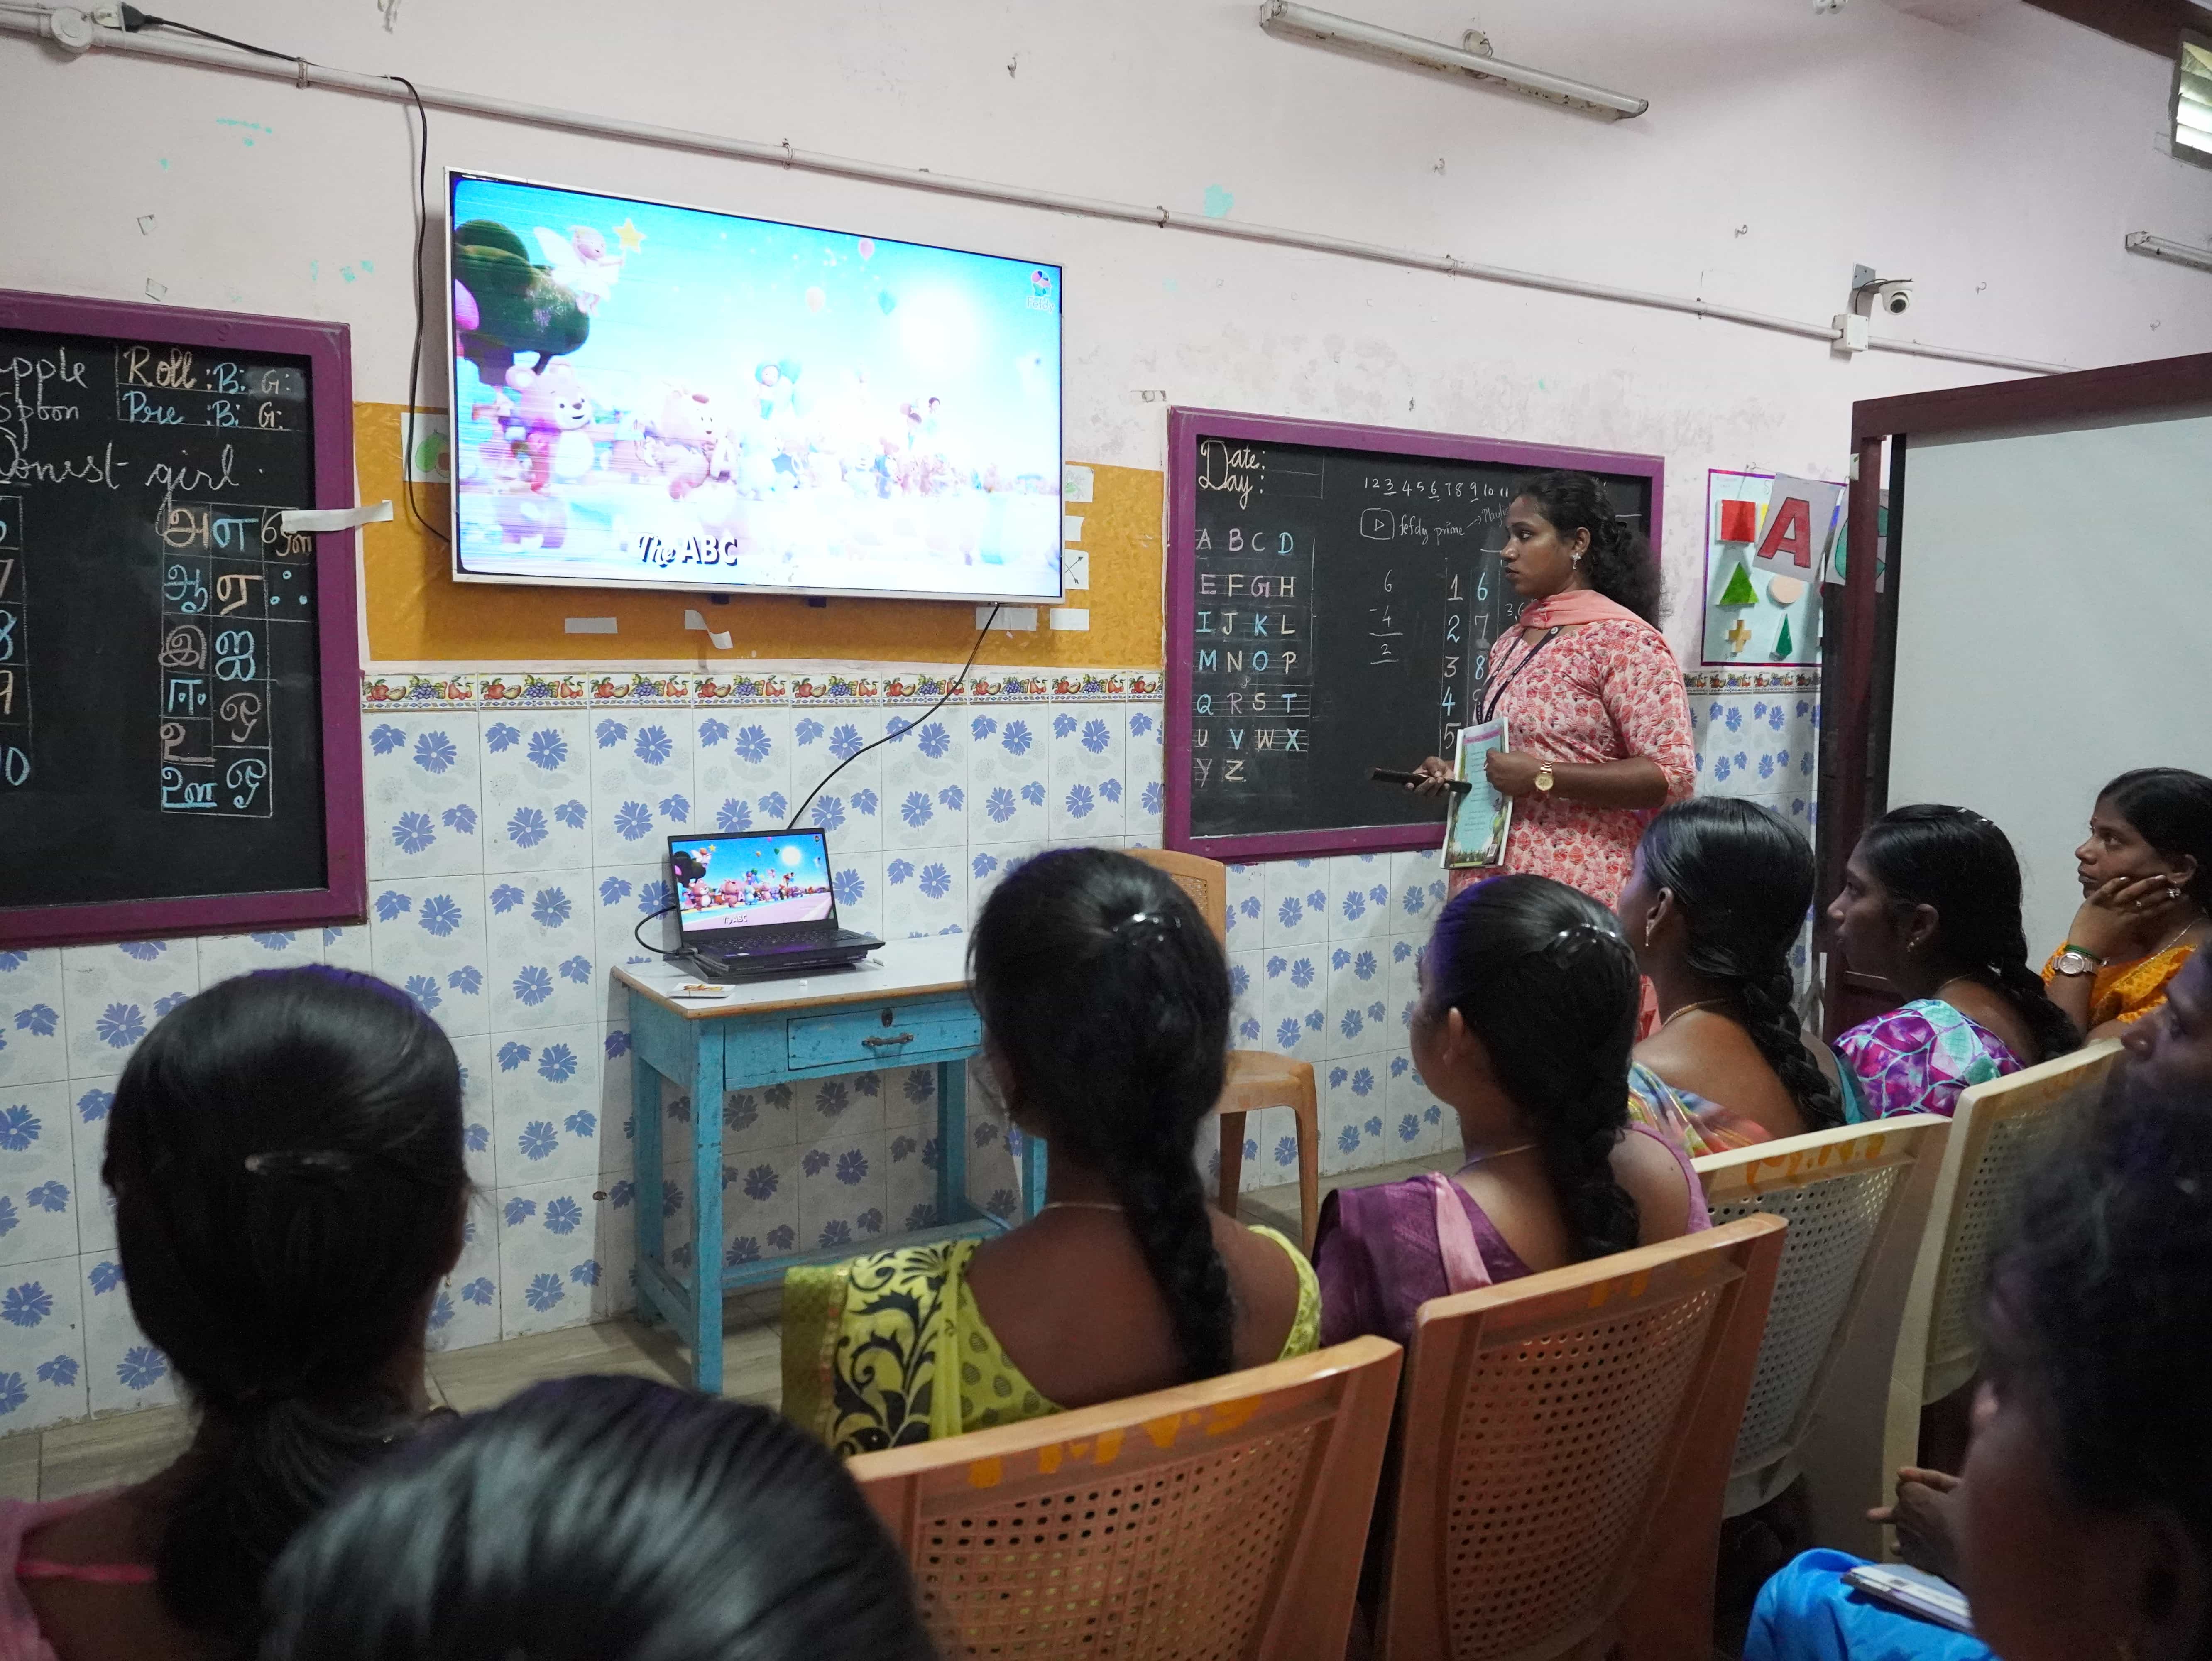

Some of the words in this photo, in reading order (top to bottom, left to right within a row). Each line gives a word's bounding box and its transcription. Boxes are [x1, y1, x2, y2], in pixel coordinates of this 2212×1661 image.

[1027, 296, 1054, 313] Fefdy
[0, 347, 88, 409] pple
[1365, 477, 1368, 488] 1
[1372, 479, 1380, 488] 2
[1385, 479, 1394, 491] 3
[1402, 480, 1412, 497] 4
[1417, 481, 1424, 492] 5
[1431, 480, 1437, 495] 6
[1455, 483, 1463, 497] 8
[1470, 482, 1477, 497] 9
[1484, 483, 1494, 497] 10
[166, 509, 209, 549] அ
[1197, 528, 1211, 551] A
[1228, 528, 1244, 552] B
[1252, 532, 1265, 551] C
[1278, 532, 1294, 554] D
[1757, 497, 1811, 569] A
[638, 533, 676, 568] The
[682, 534, 738, 566] ABC
[165, 564, 208, 614] ஆ
[1201, 574, 1216, 595] E
[1228, 574, 1244, 597] F
[1250, 575, 1270, 598] G
[1280, 576, 1294, 598] H
[1384, 569, 1392, 592] 6
[1448, 574, 1463, 601] 1
[1477, 572, 1488, 601] 6
[1195, 611, 1211, 632] I
[1222, 612, 1238, 635] J
[1255, 613, 1268, 637] K
[1281, 614, 1296, 635] L
[1446, 615, 1460, 644] 2
[158, 625, 207, 669] இ
[1199, 649, 1216, 671] M
[1227, 650, 1243, 673] N
[1252, 650, 1268, 671] O
[1282, 651, 1296, 674] P
[1444, 656, 1460, 678] 3
[1475, 655, 1485, 680] 8
[1196, 694, 1214, 715] Q
[1227, 692, 1243, 715] R
[1252, 692, 1266, 711] S
[1281, 693, 1297, 713] T
[1442, 686, 1456, 716] 4
[1198, 728, 1208, 747] U
[1229, 728, 1244, 750] V
[1258, 728, 1275, 750] W
[1285, 728, 1300, 751] X
[1444, 723, 1462, 750] 5
[1196, 758, 1213, 789] Y
[1224, 760, 1244, 781] Z
[732, 914, 748, 923] ABC
